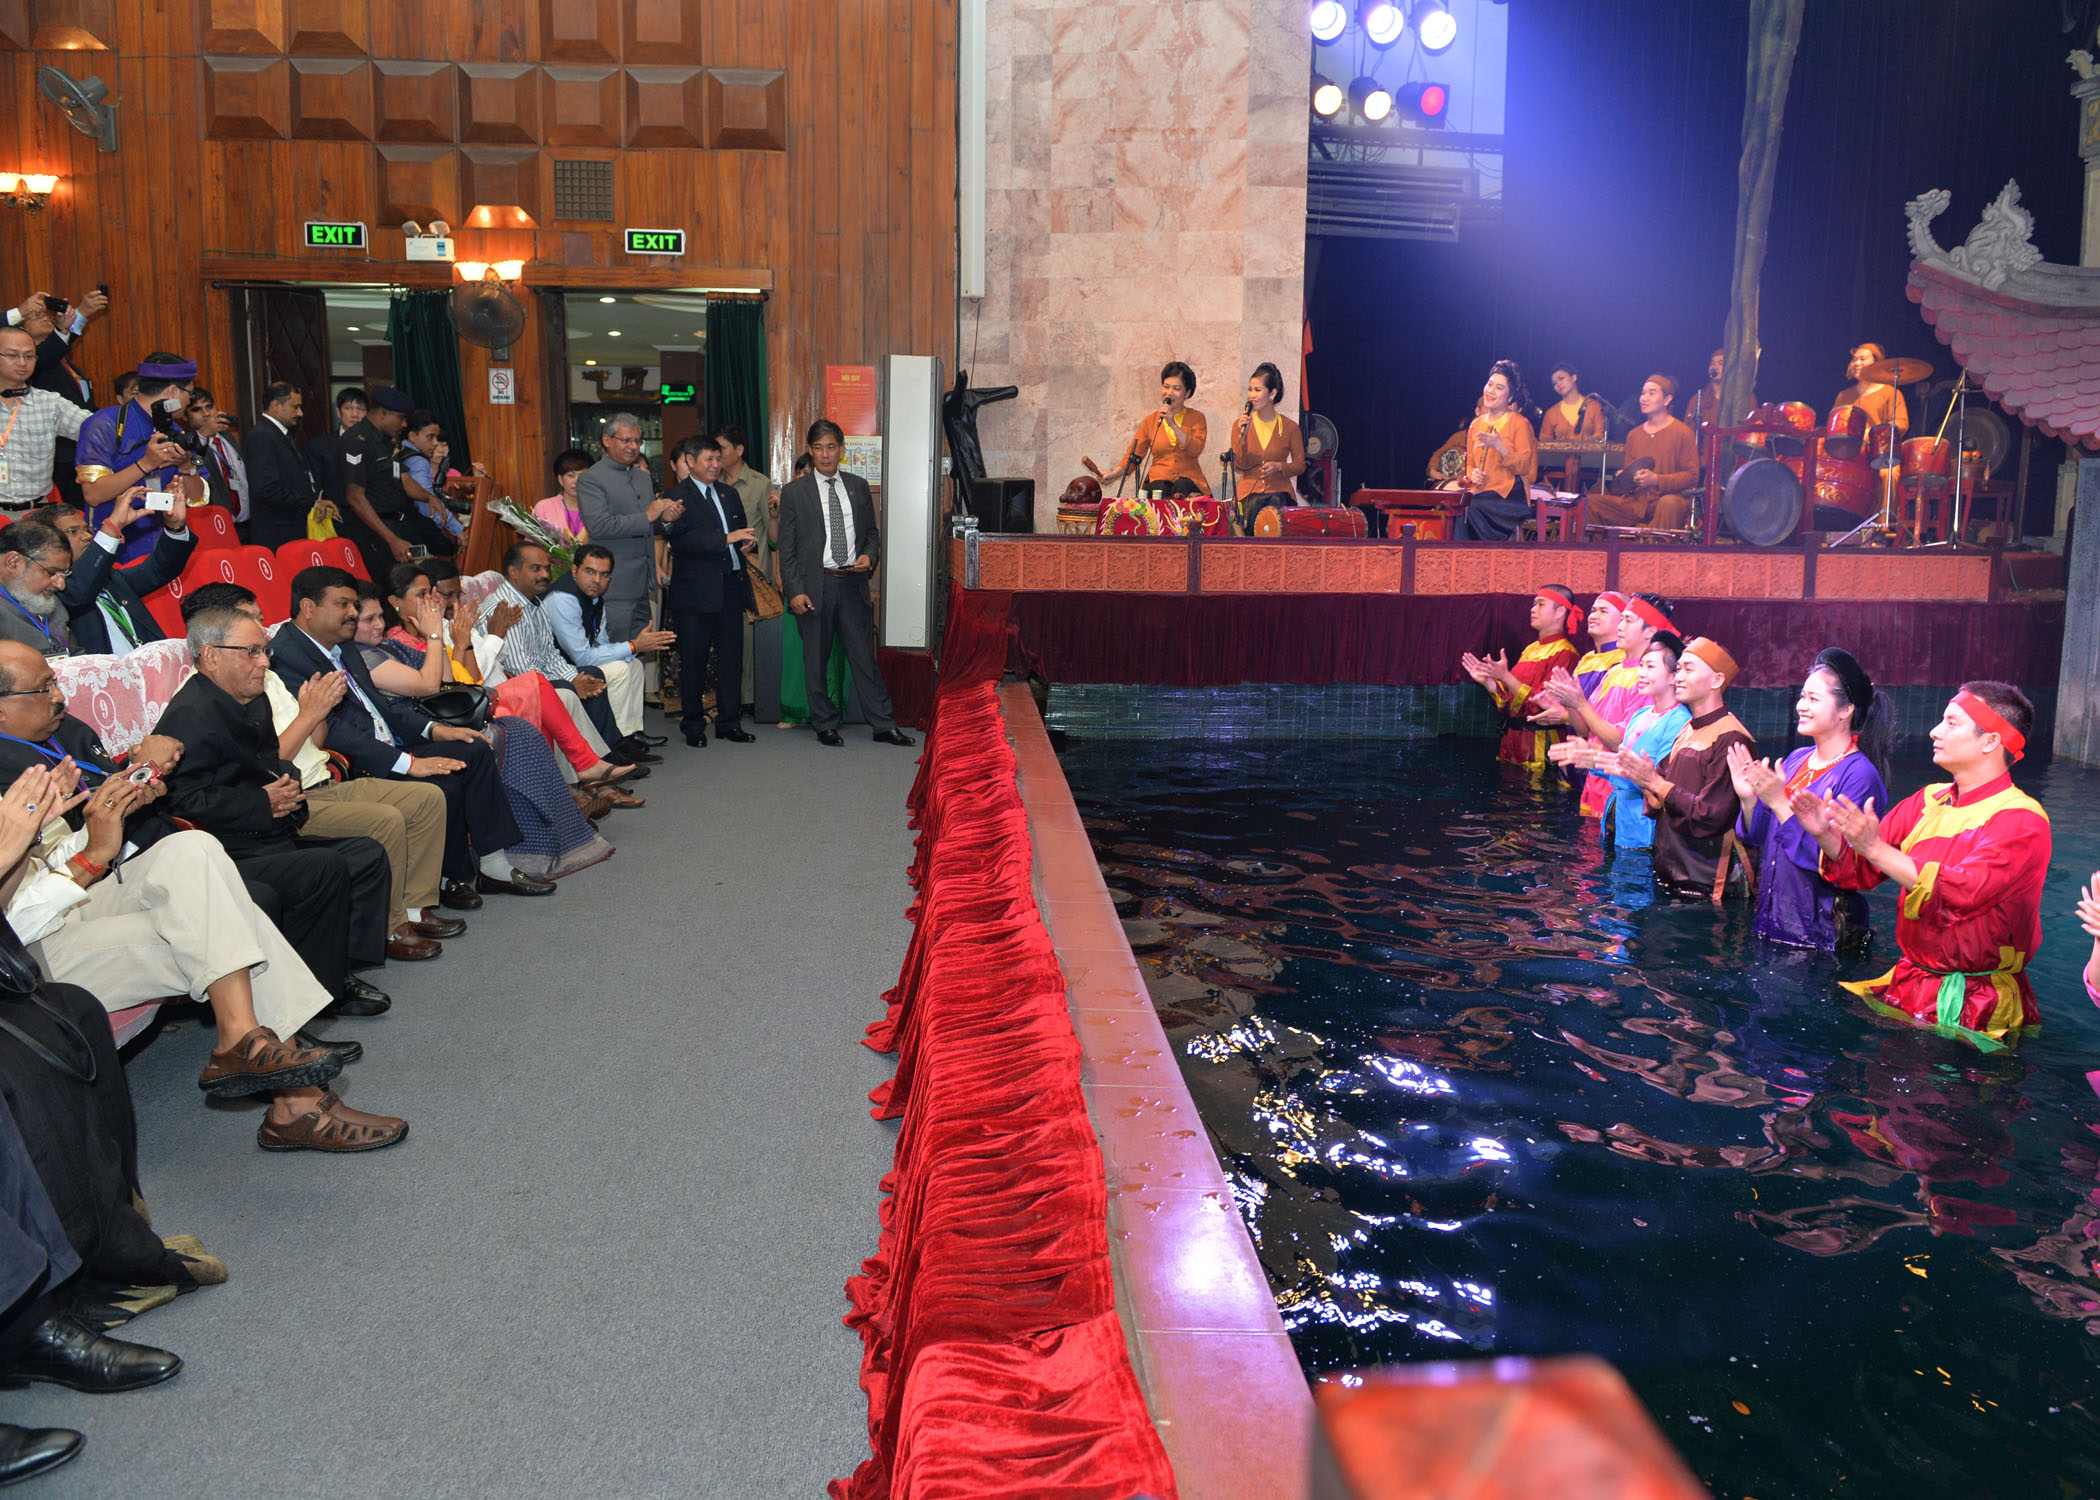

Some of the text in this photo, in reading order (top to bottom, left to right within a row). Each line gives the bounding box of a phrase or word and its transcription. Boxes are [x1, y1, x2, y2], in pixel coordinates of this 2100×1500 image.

[312, 225, 356, 244] EXIT
[632, 233, 677, 250] EXIT
[100, 699, 108, 719] 9
